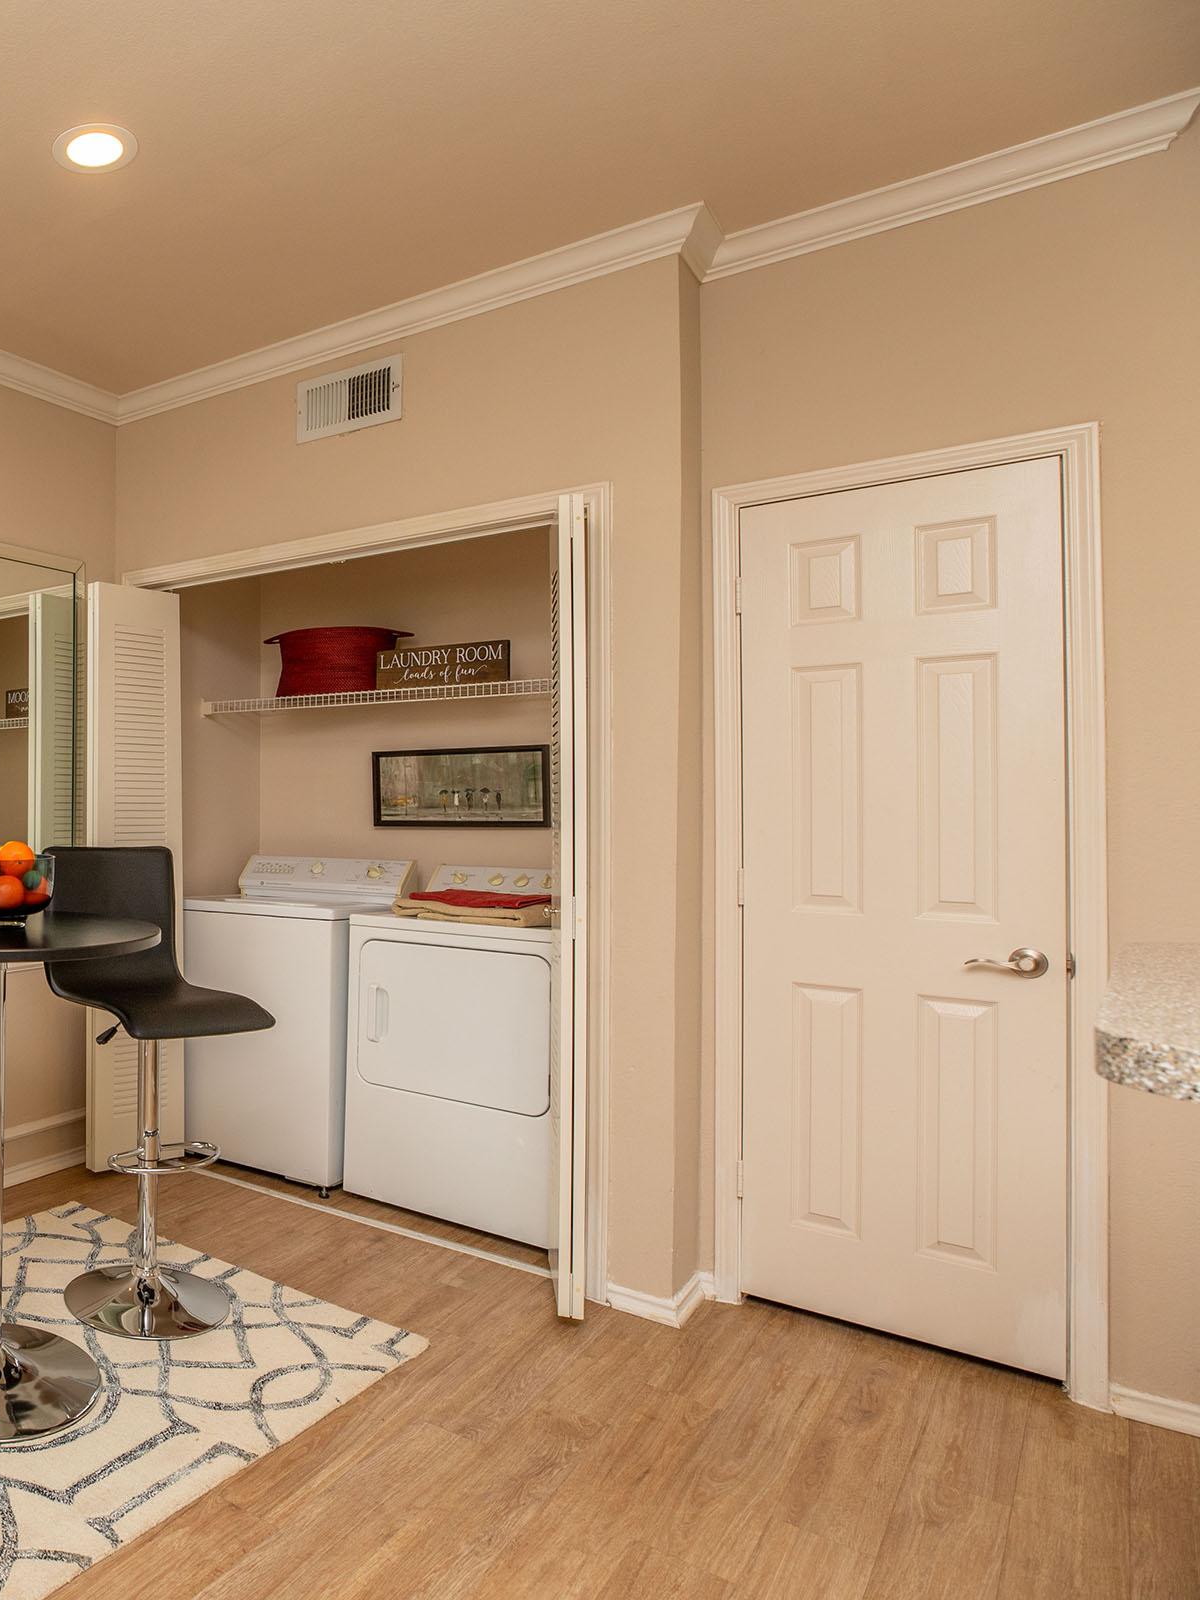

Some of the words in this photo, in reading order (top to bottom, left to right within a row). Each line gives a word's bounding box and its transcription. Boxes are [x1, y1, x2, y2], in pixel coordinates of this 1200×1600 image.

[380, 648, 451, 670] LAUNDRY
[456, 644, 503, 663] ROOM
[394, 666, 436, 684] loads
[440, 665, 452, 683] of
[455, 665, 487, 682] fun
